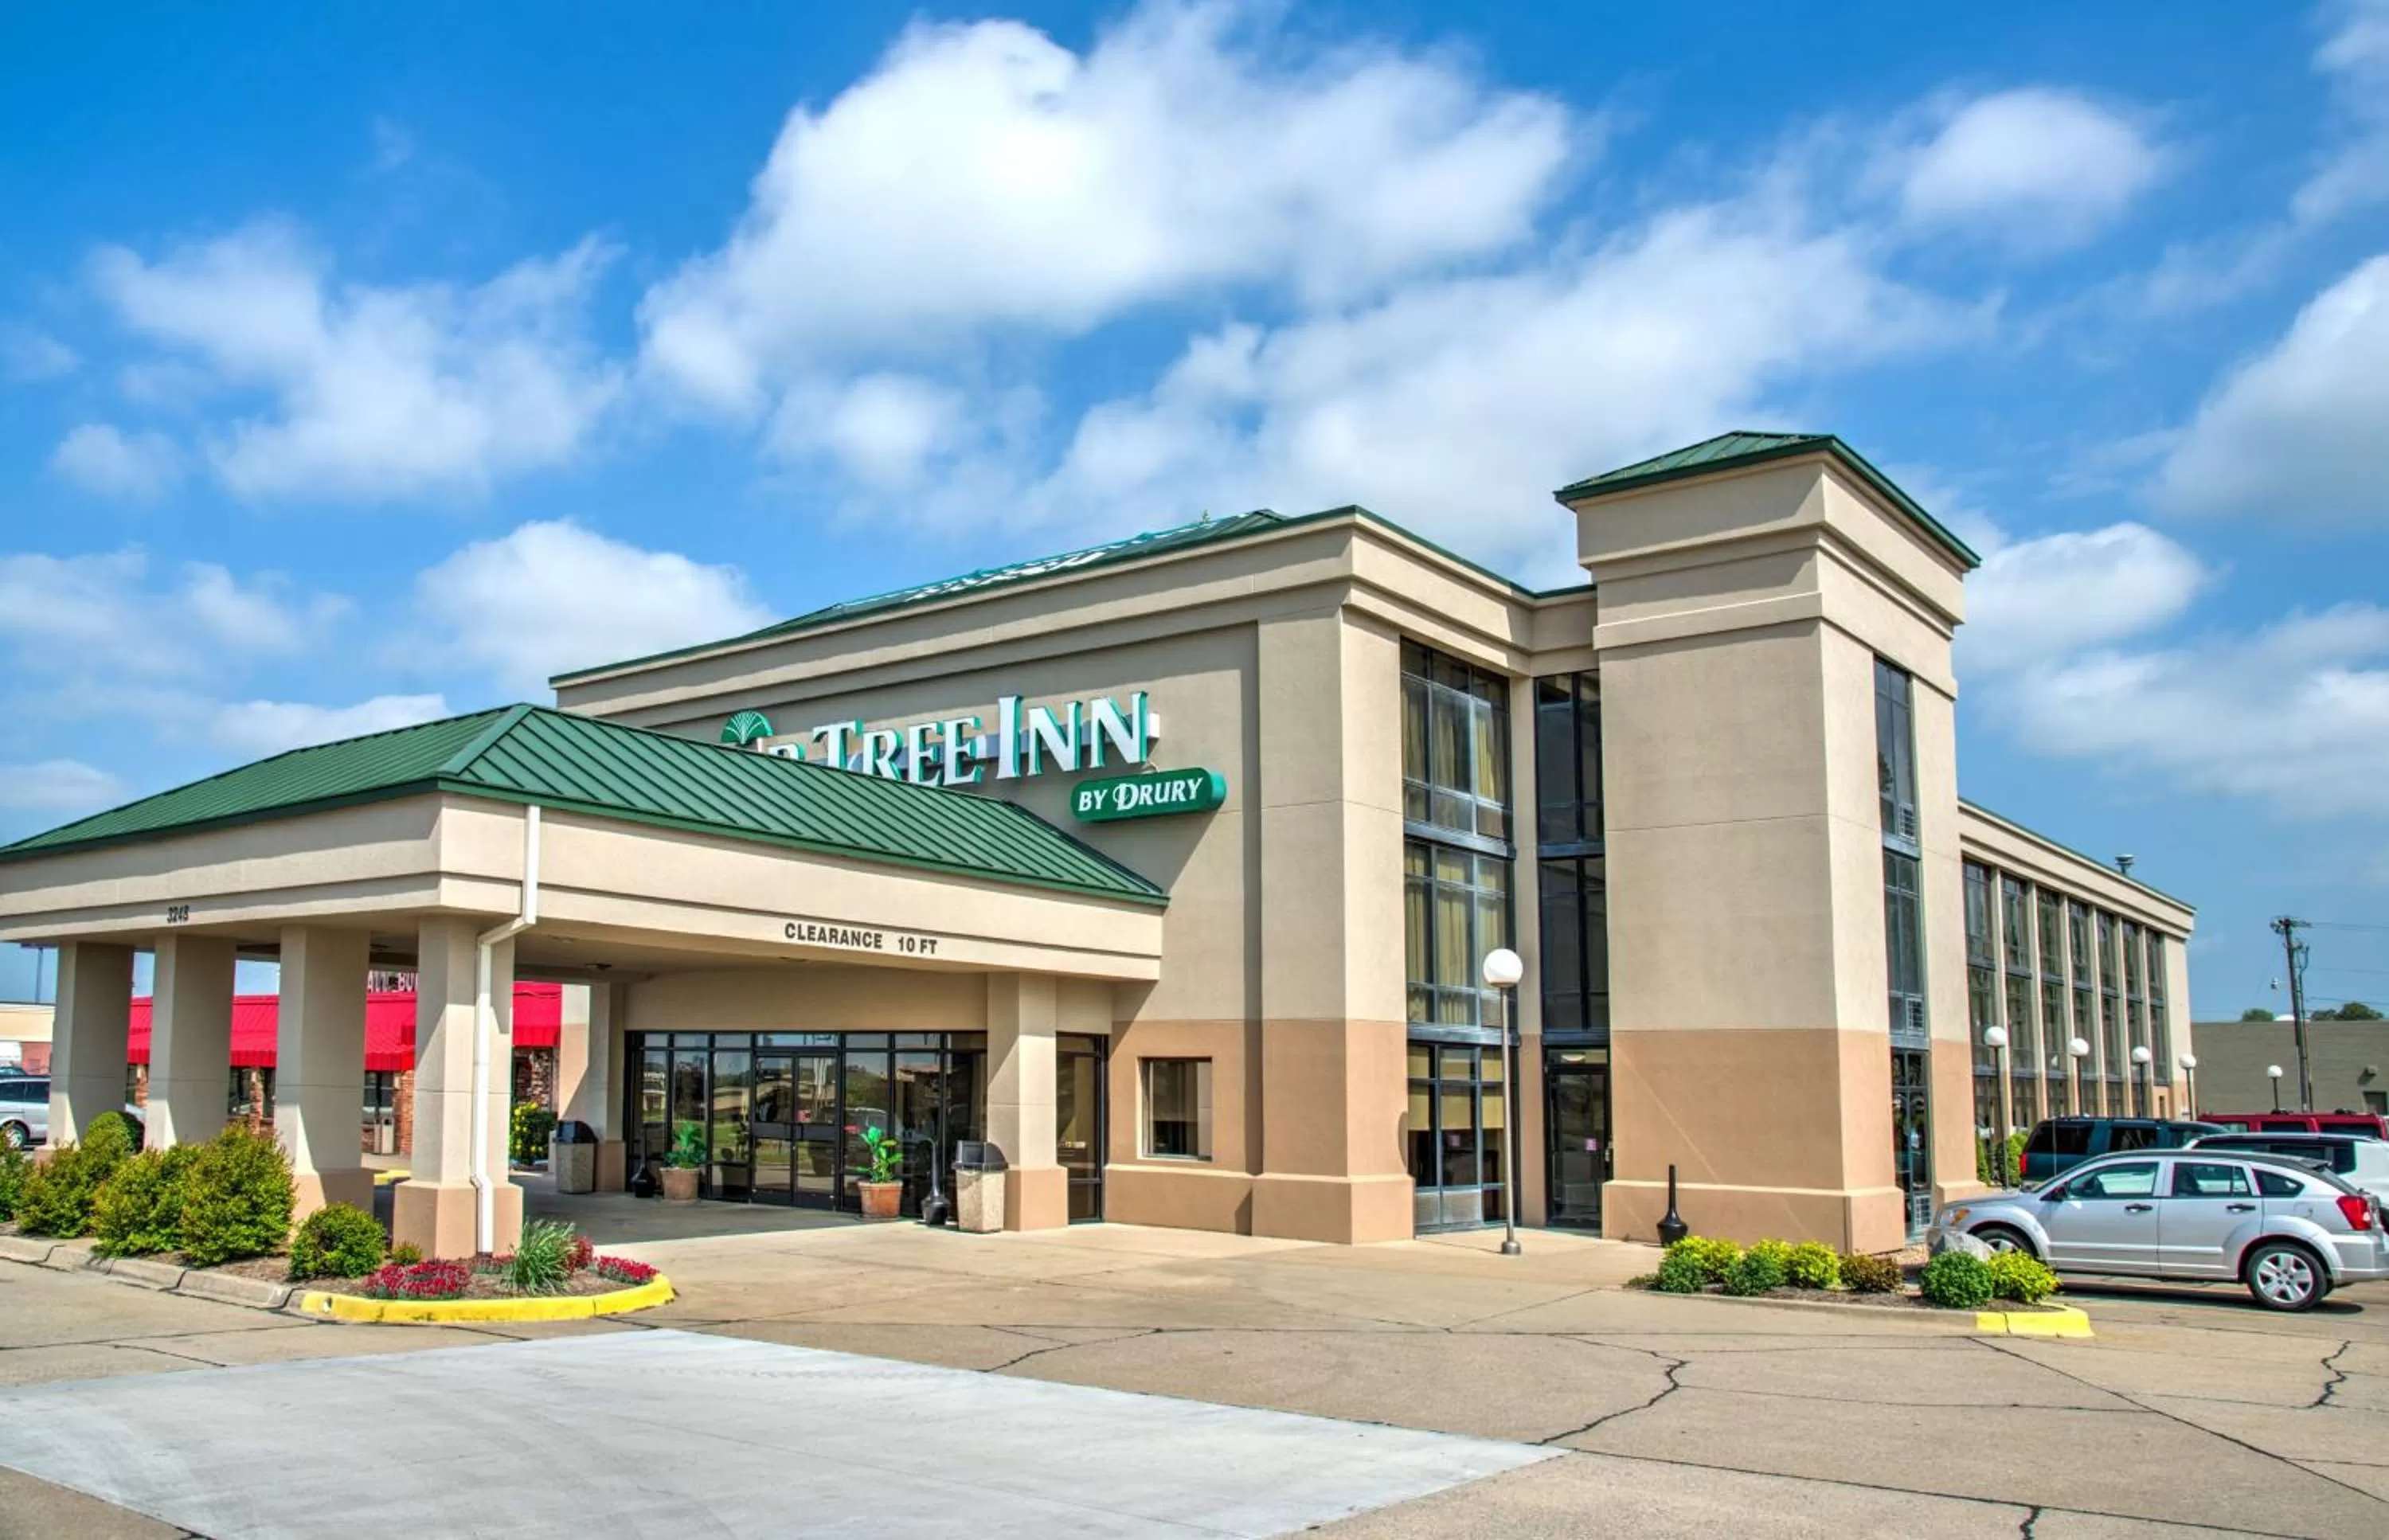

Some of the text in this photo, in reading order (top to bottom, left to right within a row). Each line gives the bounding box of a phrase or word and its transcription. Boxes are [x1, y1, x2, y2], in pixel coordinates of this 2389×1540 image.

[813, 691, 1148, 787] TREE INN
[1077, 777, 1204, 812] BY DRURY
[784, 922, 937, 954] CLEARANCE 10 FT
